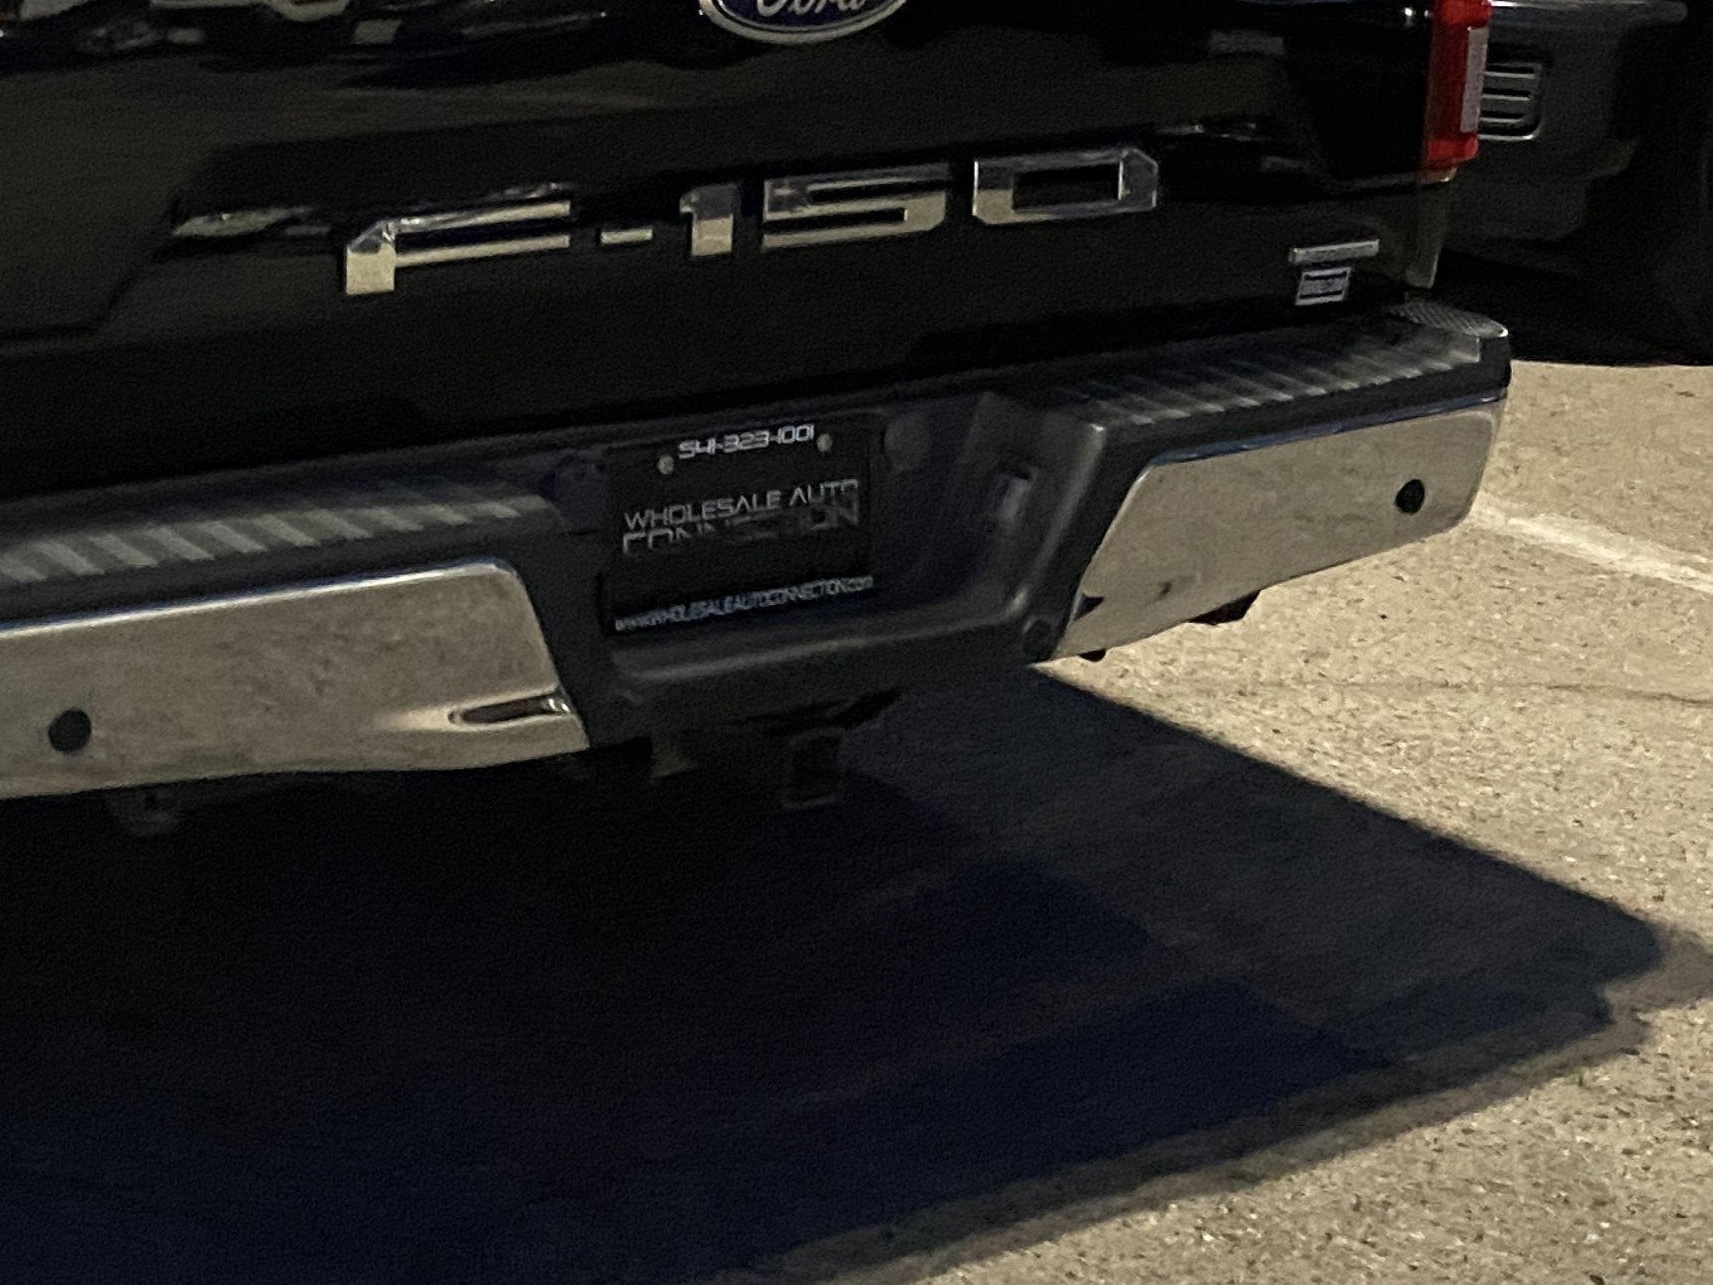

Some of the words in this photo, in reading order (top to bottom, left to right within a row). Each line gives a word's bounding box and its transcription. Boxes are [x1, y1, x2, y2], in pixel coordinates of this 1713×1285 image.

[344, 146, 1158, 295] F-150
[624, 489, 782, 530] WHOLESALE
[789, 478, 860, 507] AUTO
